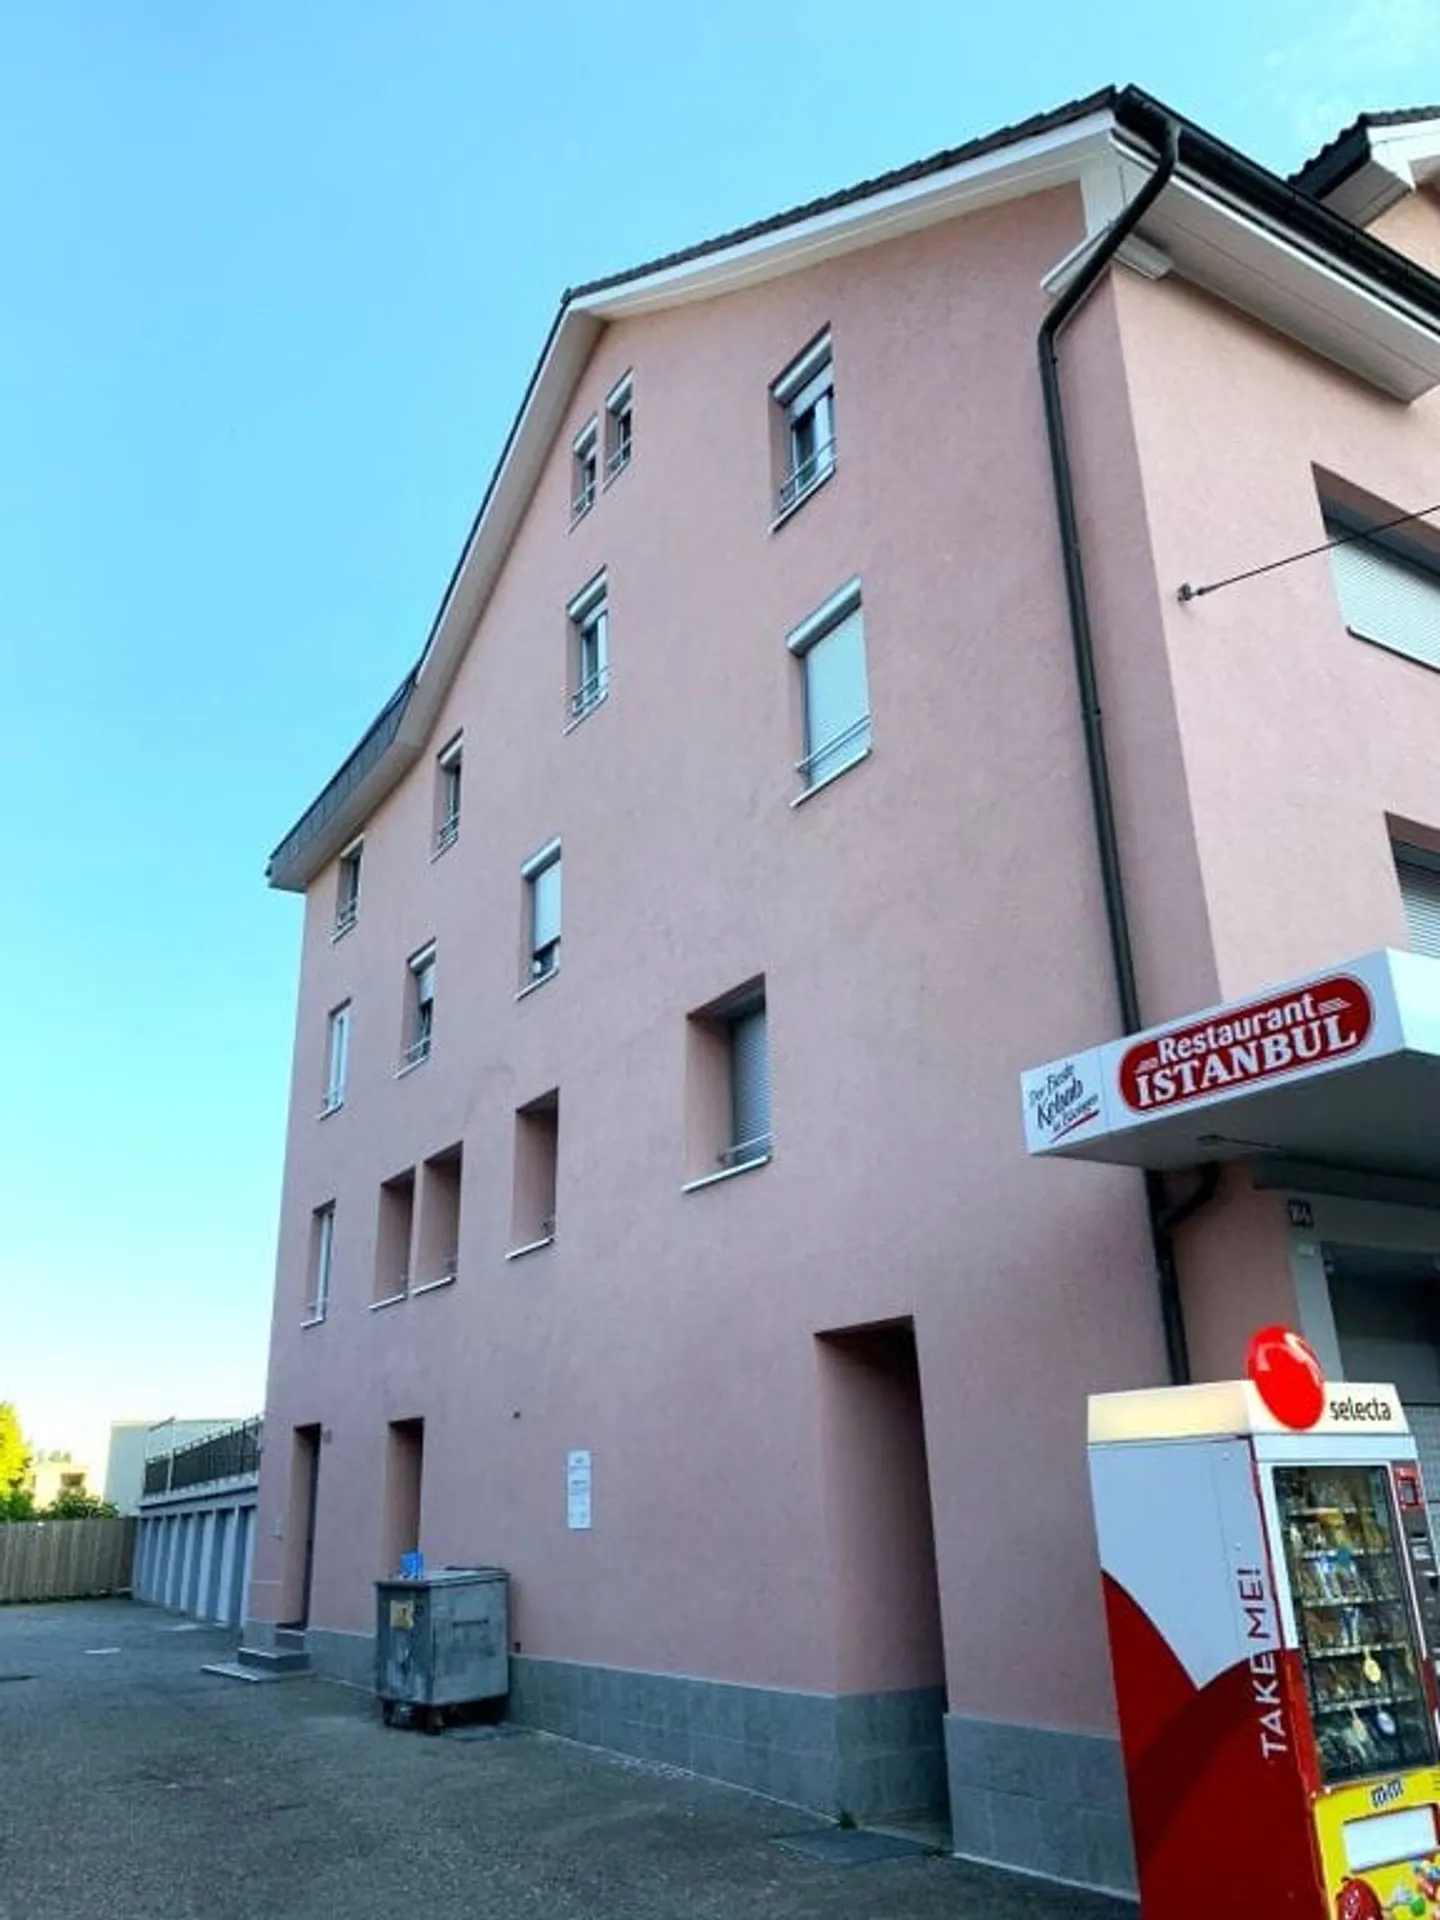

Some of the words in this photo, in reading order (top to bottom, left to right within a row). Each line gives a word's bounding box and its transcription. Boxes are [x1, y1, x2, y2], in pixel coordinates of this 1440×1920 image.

[1134, 1014, 1357, 1107] ISTANBUL
[1157, 991, 1318, 1065] Restaurant
[1329, 1395, 1392, 1421] selecta
[1237, 1566, 1270, 1640] ME!
[1251, 1651, 1288, 1760] TAKE
